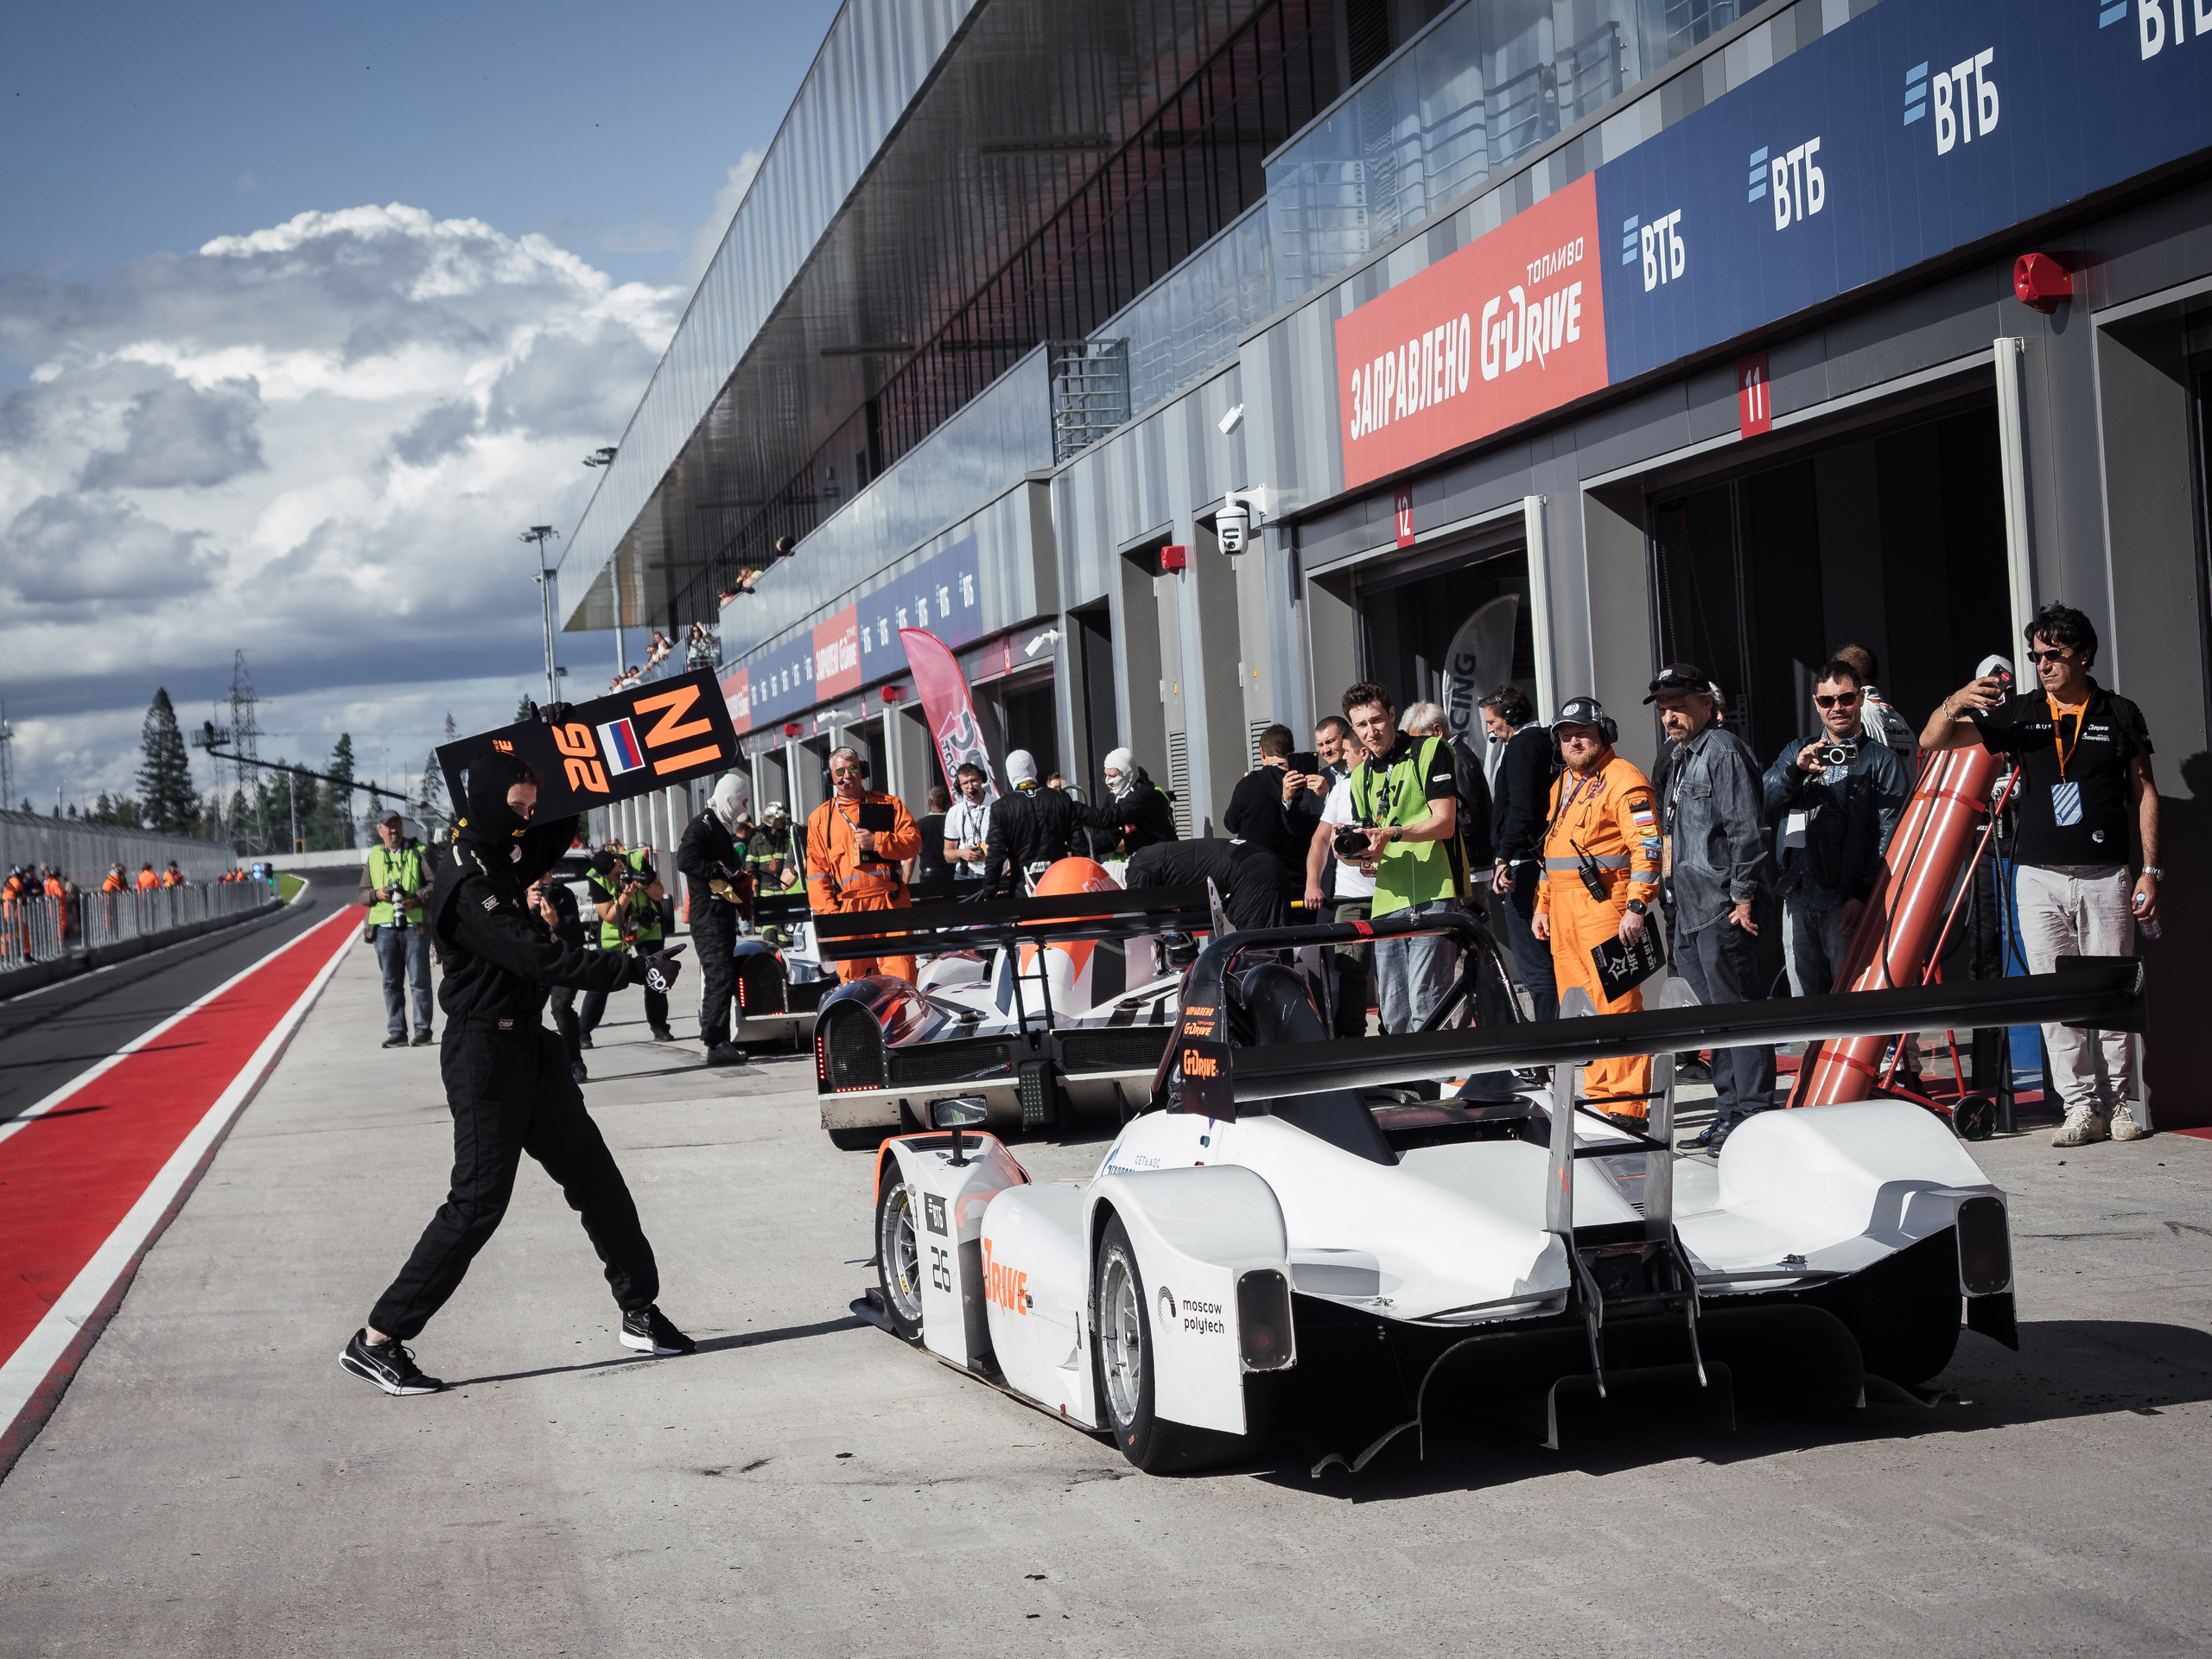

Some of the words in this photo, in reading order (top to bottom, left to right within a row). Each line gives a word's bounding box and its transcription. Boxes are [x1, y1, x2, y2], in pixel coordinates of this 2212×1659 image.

[1933, 47, 1999, 156] ВТБ
[1771, 136, 1826, 232] ВТБ
[1526, 237, 1584, 286] ТОПЛИВО
[1641, 208, 1686, 293] ВТБ
[1351, 313, 1471, 441] ЗАПРАВЛЕНО
[1744, 363, 1764, 425] 11
[1397, 496, 1411, 537] 12
[551, 722, 610, 793] 26
[632, 684, 722, 776] IN
[484, 897, 499, 909] OMP
[932, 1204, 944, 1229] ВТБ
[931, 1245, 951, 1294] 26
[1183, 1300, 1222, 1314] moscow
[1184, 1316, 1224, 1334] polytech
